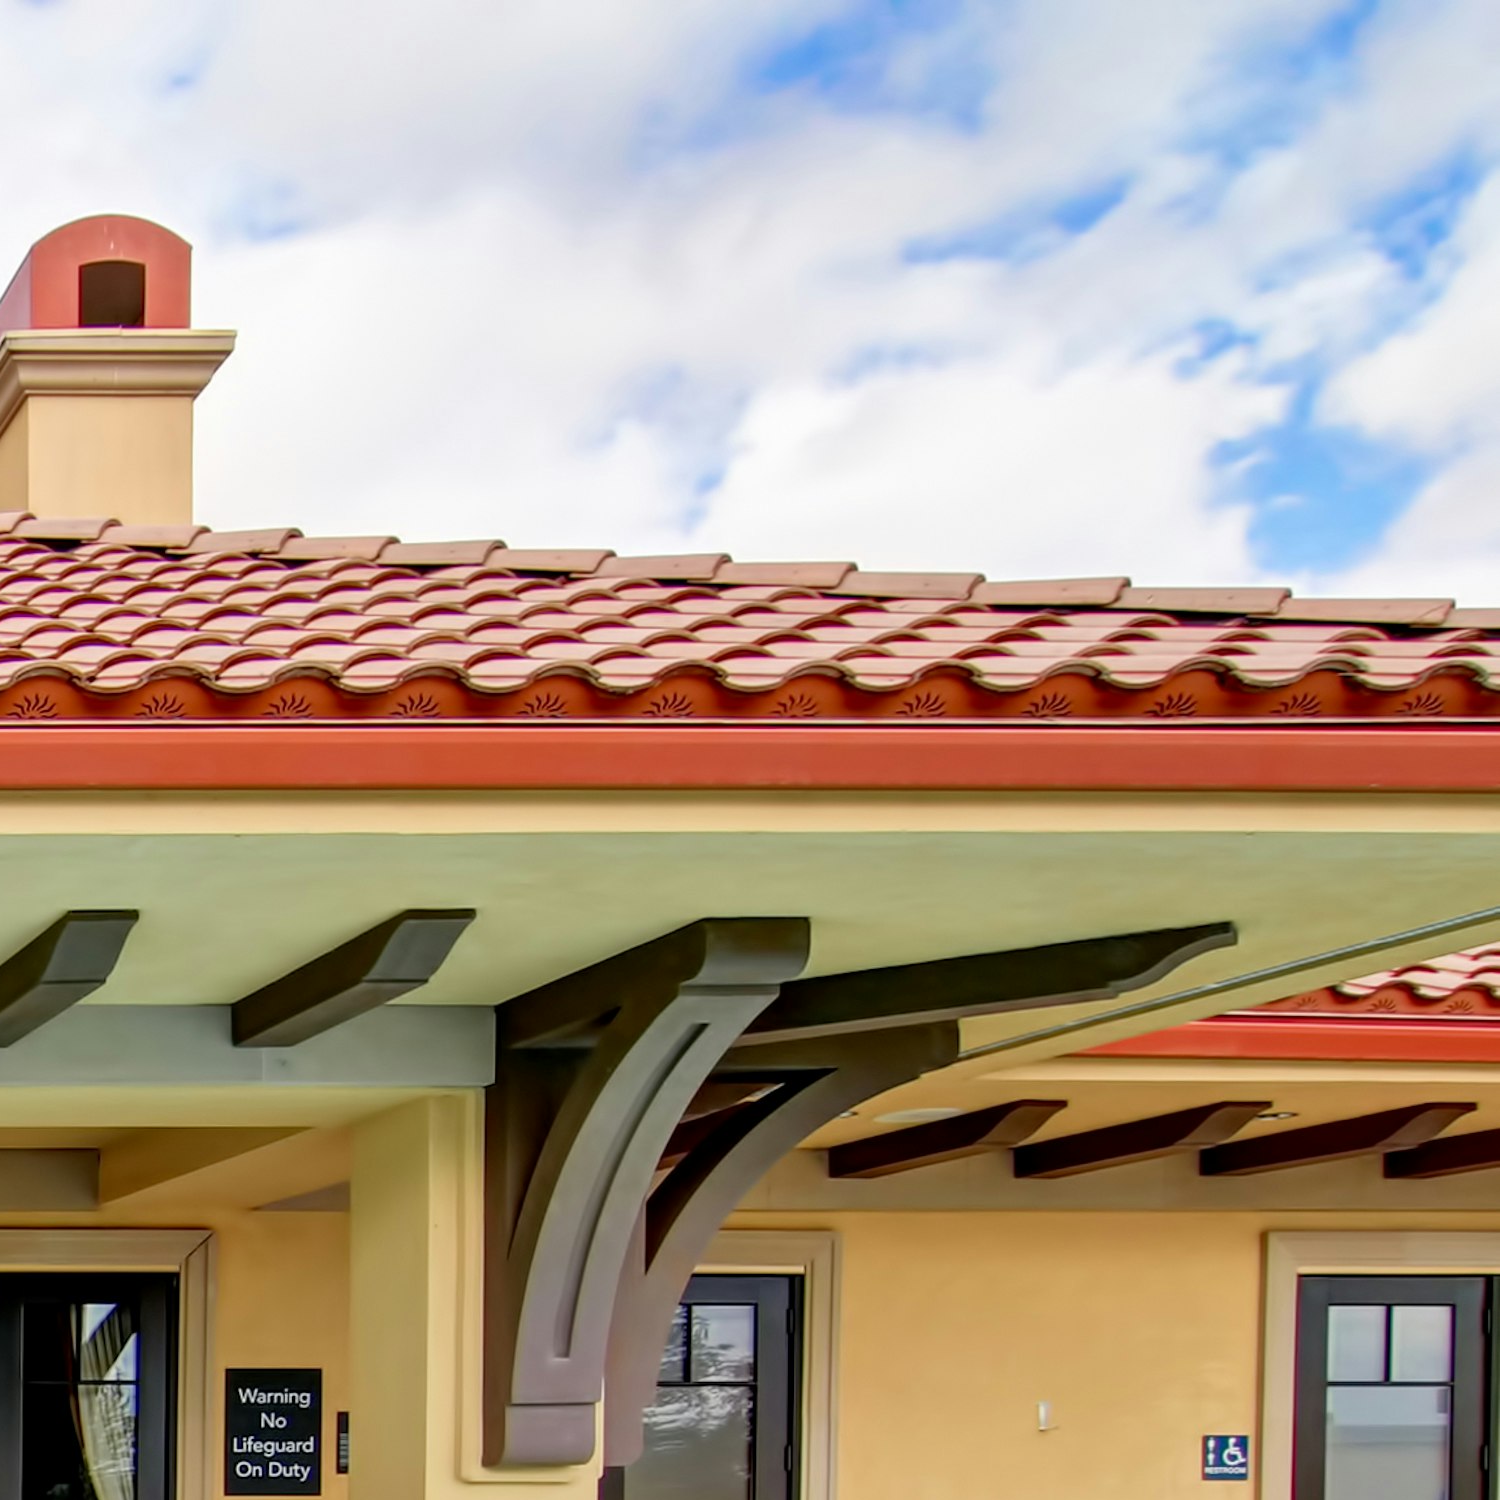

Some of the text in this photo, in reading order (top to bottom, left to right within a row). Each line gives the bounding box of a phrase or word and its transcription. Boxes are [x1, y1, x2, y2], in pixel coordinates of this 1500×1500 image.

[238, 1388, 311, 1408] Warning
[260, 1412, 288, 1429] No
[232, 1436, 315, 1458] Lifeguard
[235, 1461, 311, 1482] On Duty
